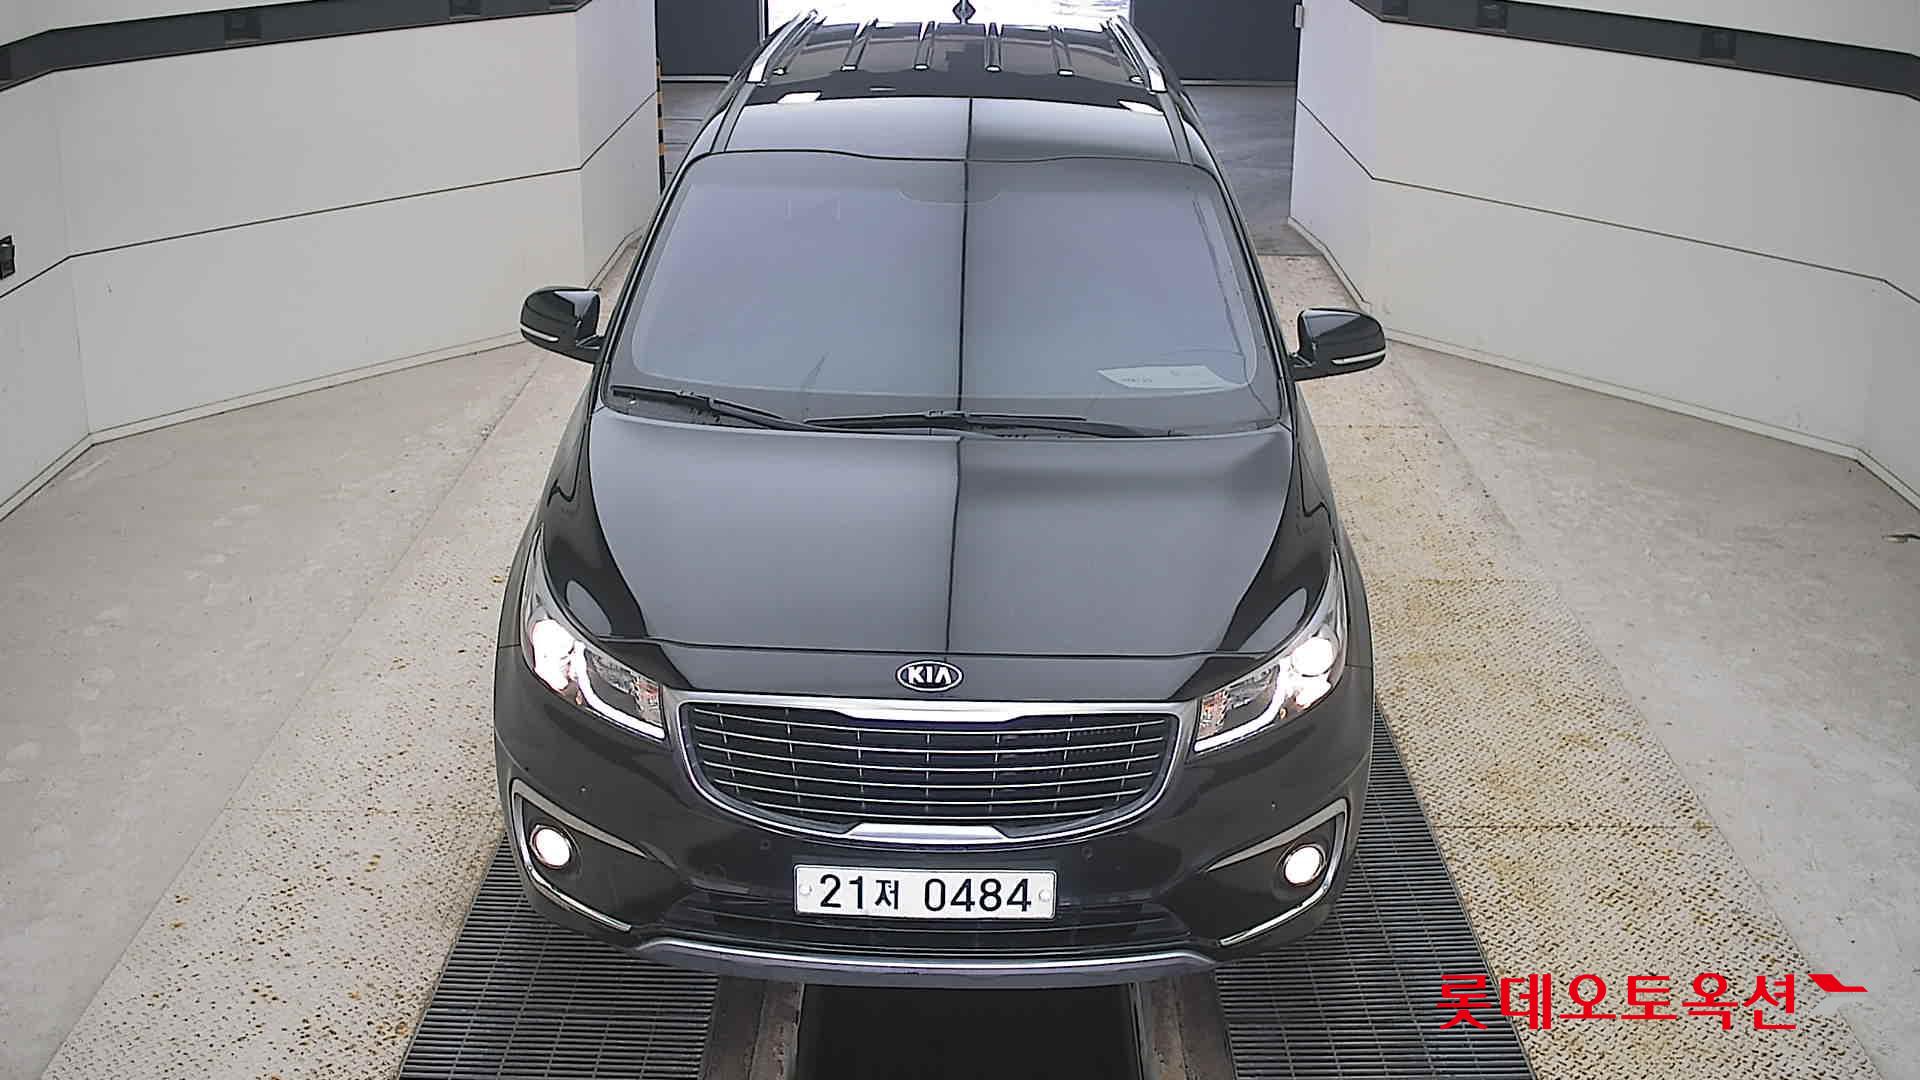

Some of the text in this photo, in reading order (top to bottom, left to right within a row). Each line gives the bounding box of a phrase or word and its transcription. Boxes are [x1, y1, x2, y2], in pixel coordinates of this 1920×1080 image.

[908, 665, 952, 685] KIA
[820, 874, 1032, 912] 21저 0484
